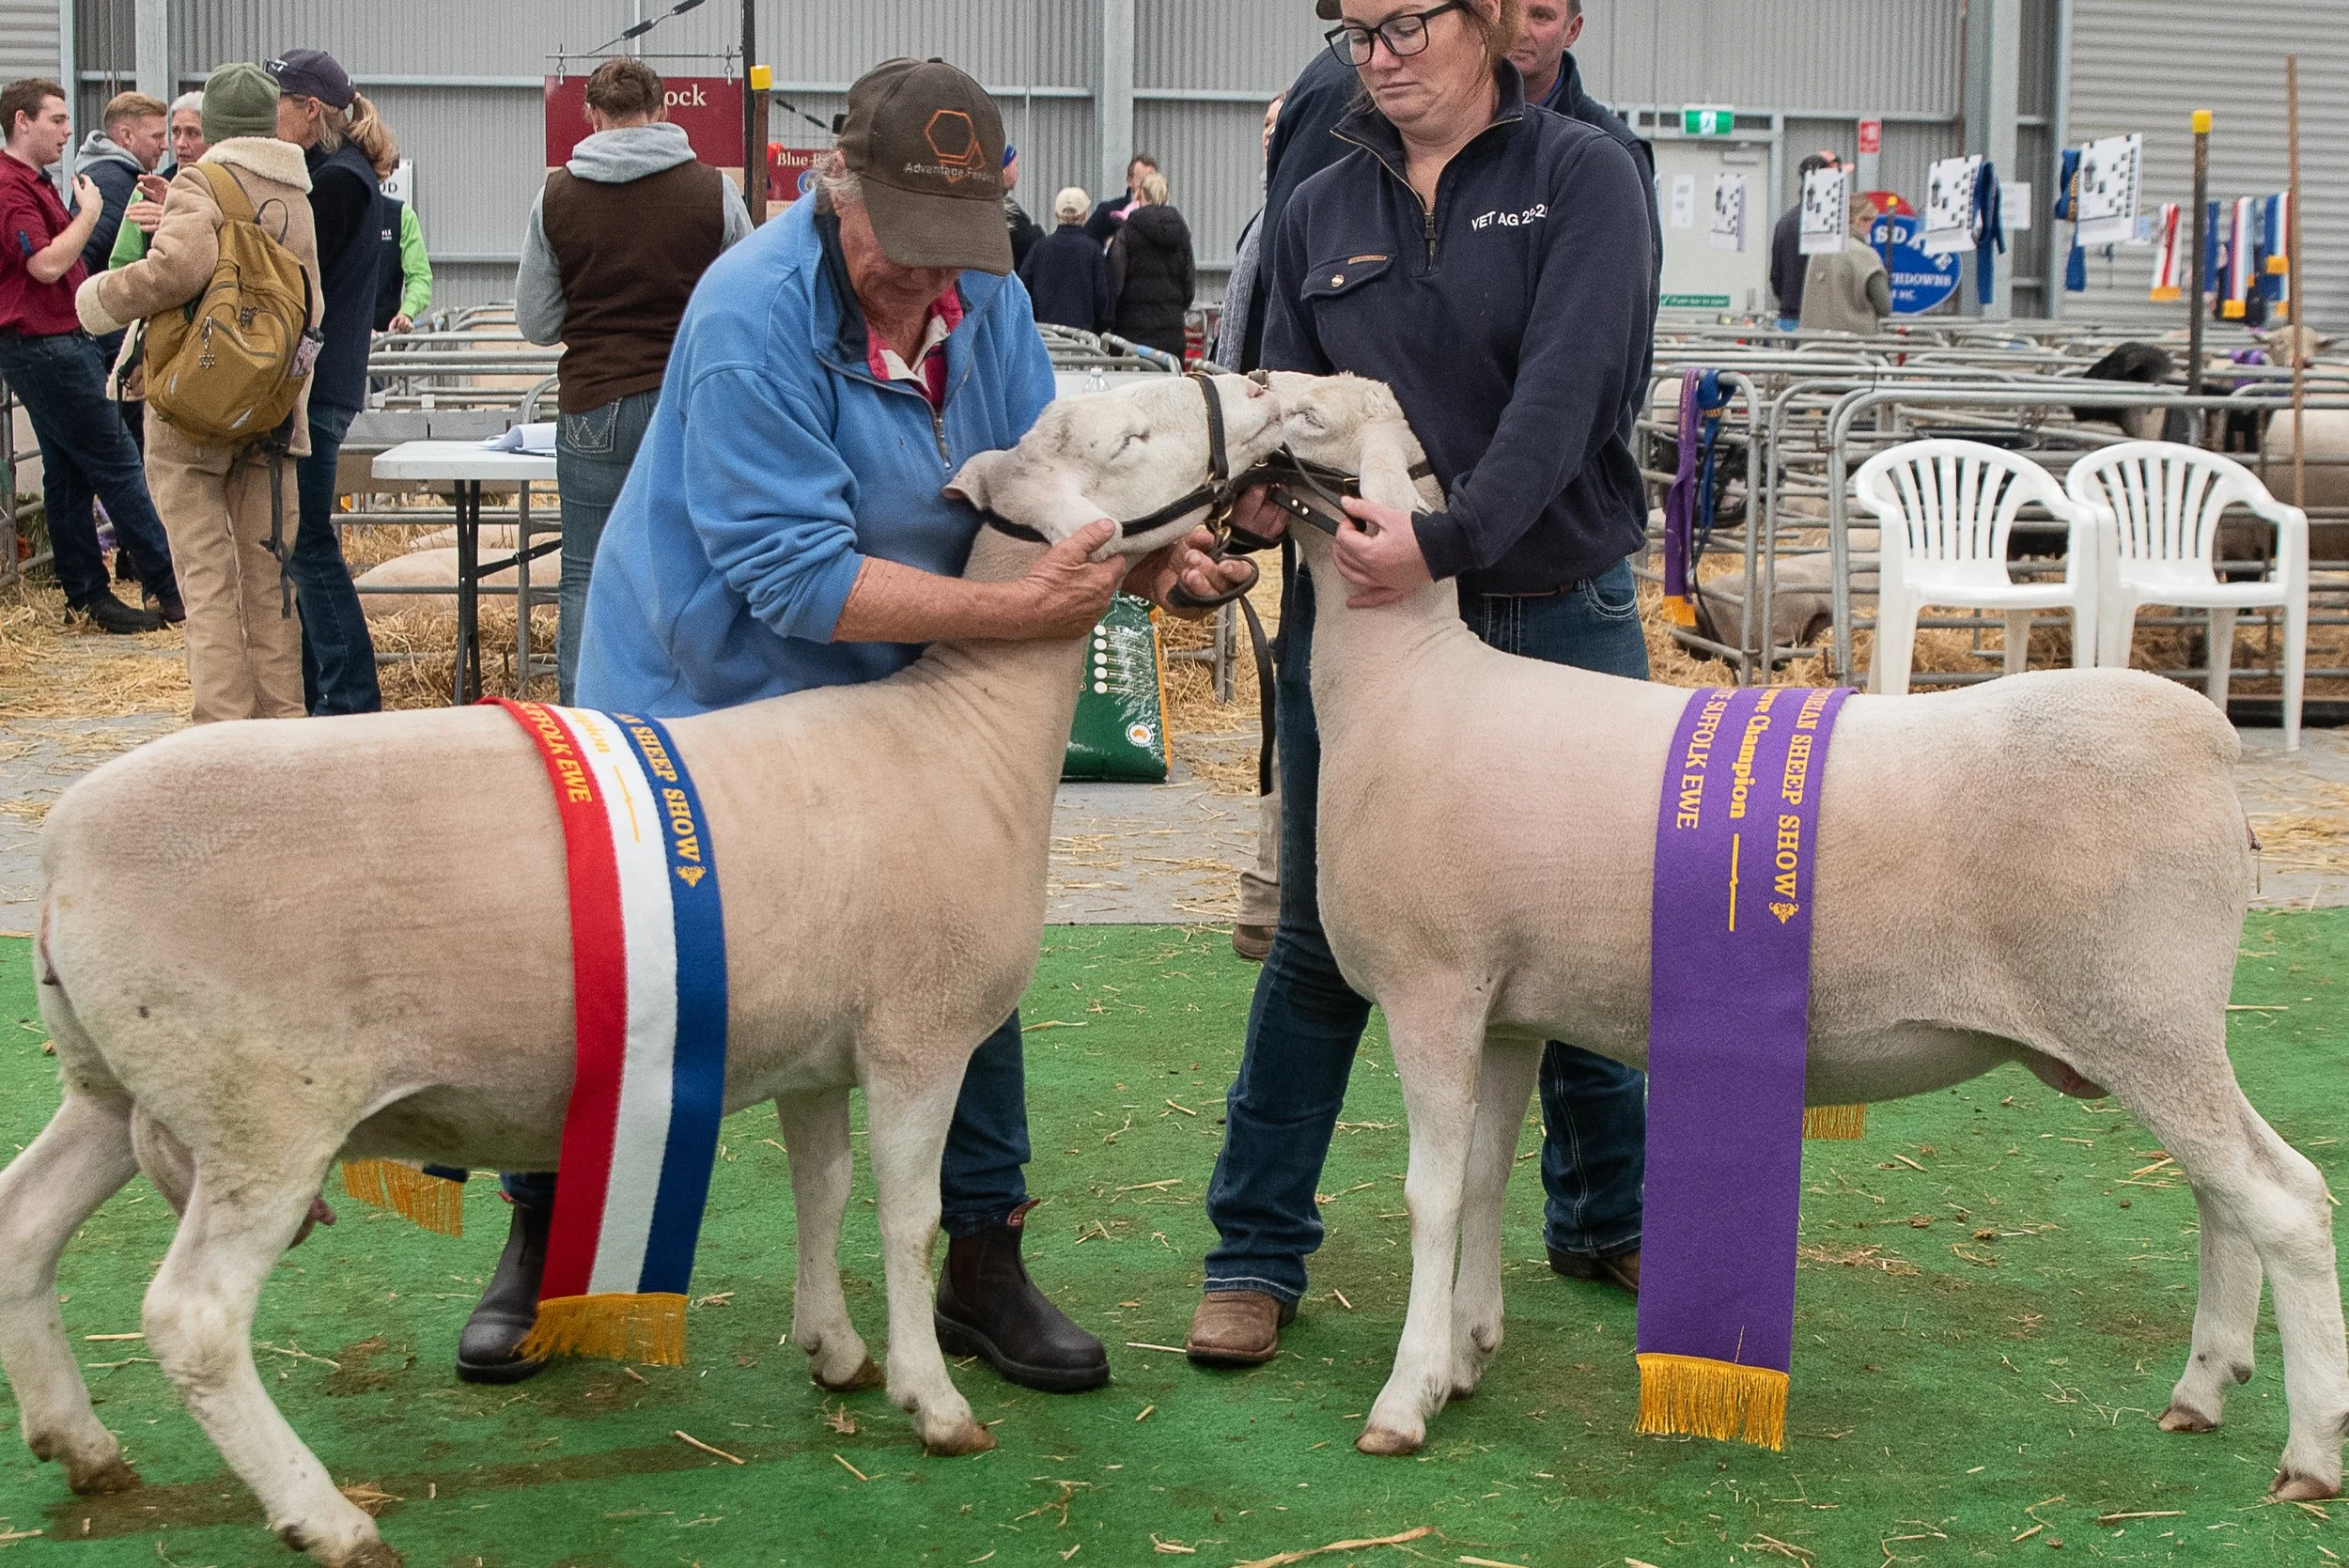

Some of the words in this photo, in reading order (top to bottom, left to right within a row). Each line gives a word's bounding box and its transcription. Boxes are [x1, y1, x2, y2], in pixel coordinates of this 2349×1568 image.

[663, 84, 707, 106] ock
[777, 151, 808, 166] Blue
[904, 163, 964, 178] Advantage
[1471, 210, 1497, 232] VET
[1498, 211, 1519, 225] AG
[1686, 701, 1728, 768] SUFFOLK
[556, 757, 593, 803] EWE
[629, 726, 677, 782] SHEEP
[662, 787, 701, 862] SHOW
[1730, 715, 1771, 819] Champion
[1781, 734, 1812, 805] SHEEP
[1676, 774, 1704, 829] EWE
[1774, 815, 1800, 899] SHOW
